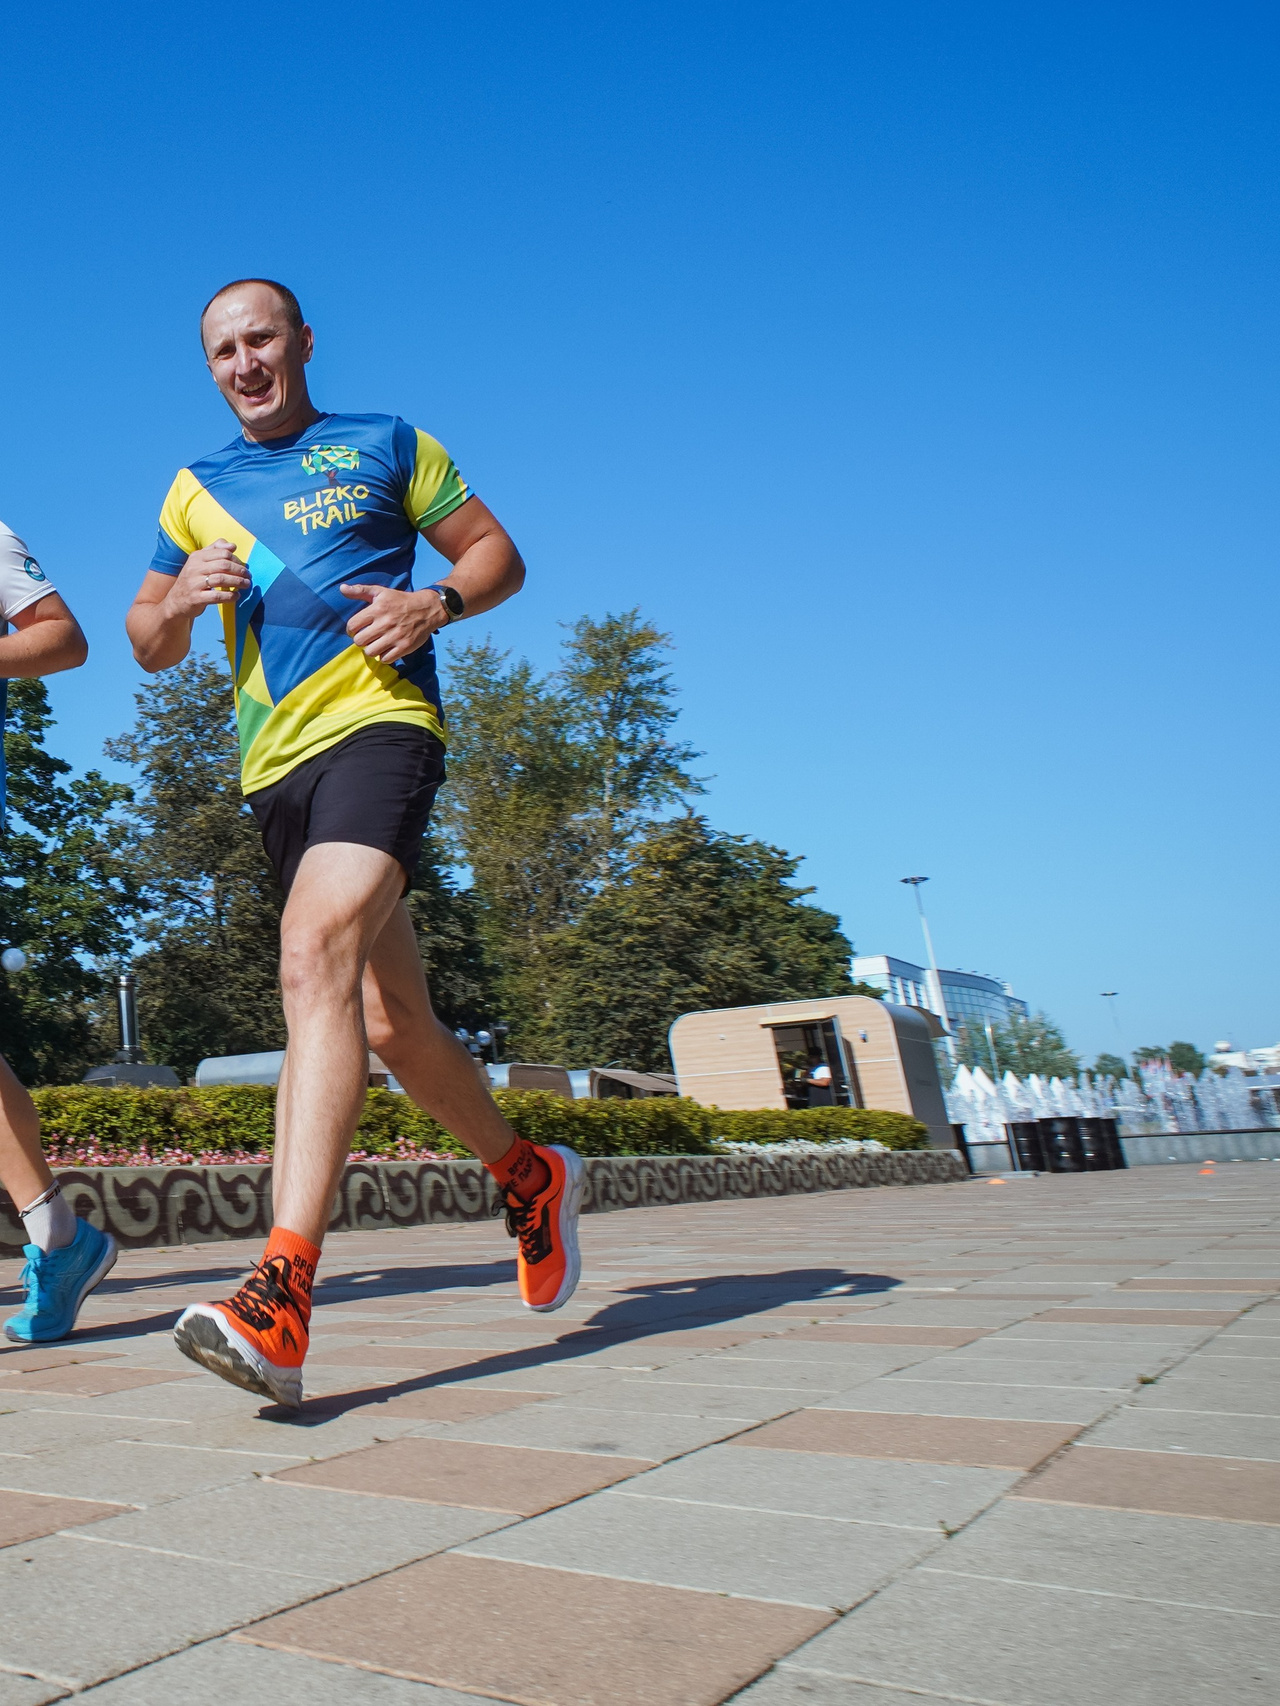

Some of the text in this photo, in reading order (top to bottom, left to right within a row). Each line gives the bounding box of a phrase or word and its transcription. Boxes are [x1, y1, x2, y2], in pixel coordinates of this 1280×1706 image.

[283, 484, 370, 521] BLIZKO
[295, 502, 367, 536] TRAIL
[293, 1254, 315, 1280] ВРО
